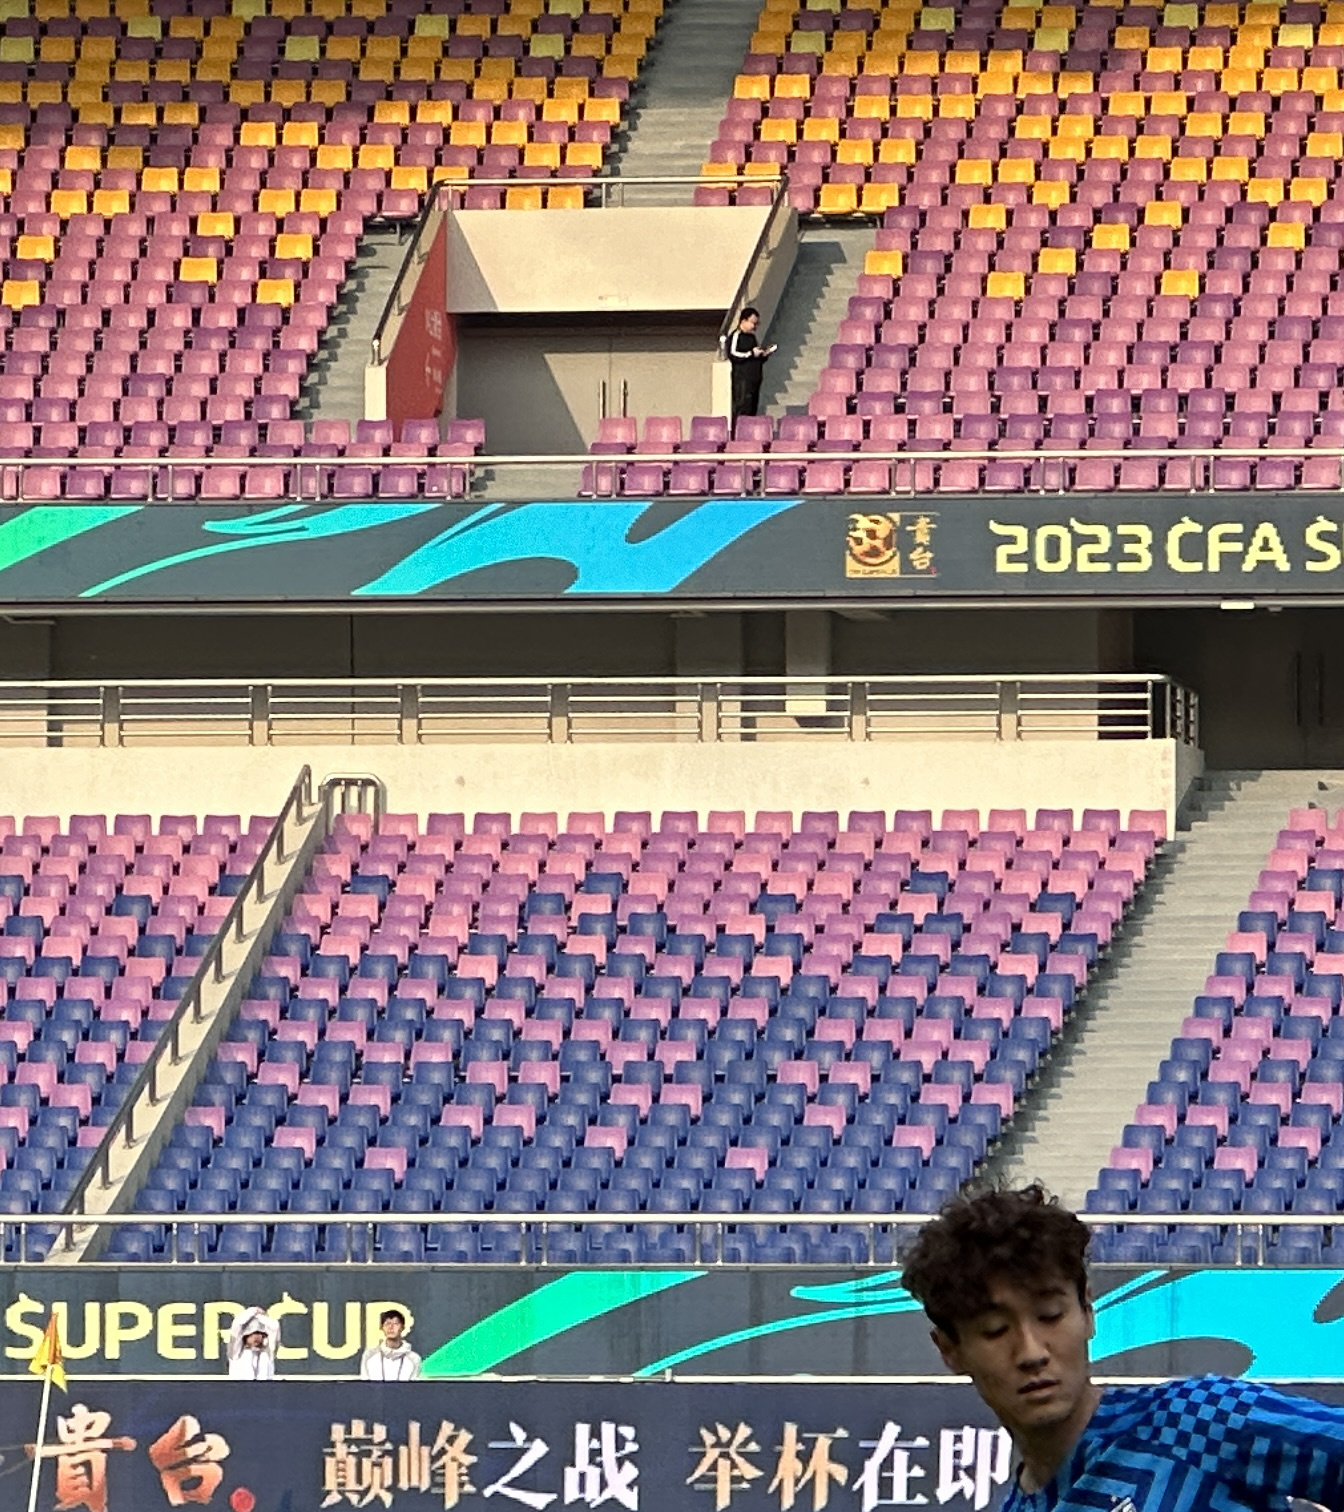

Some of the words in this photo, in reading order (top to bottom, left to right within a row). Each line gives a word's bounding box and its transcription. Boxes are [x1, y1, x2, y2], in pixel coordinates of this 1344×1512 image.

[989, 518, 1153, 573] 2023
[1167, 516, 1291, 573] CFA
[321, 1420, 639, 1509] 巅峰之战
[688, 1422, 1012, 1512] 举杯在即
